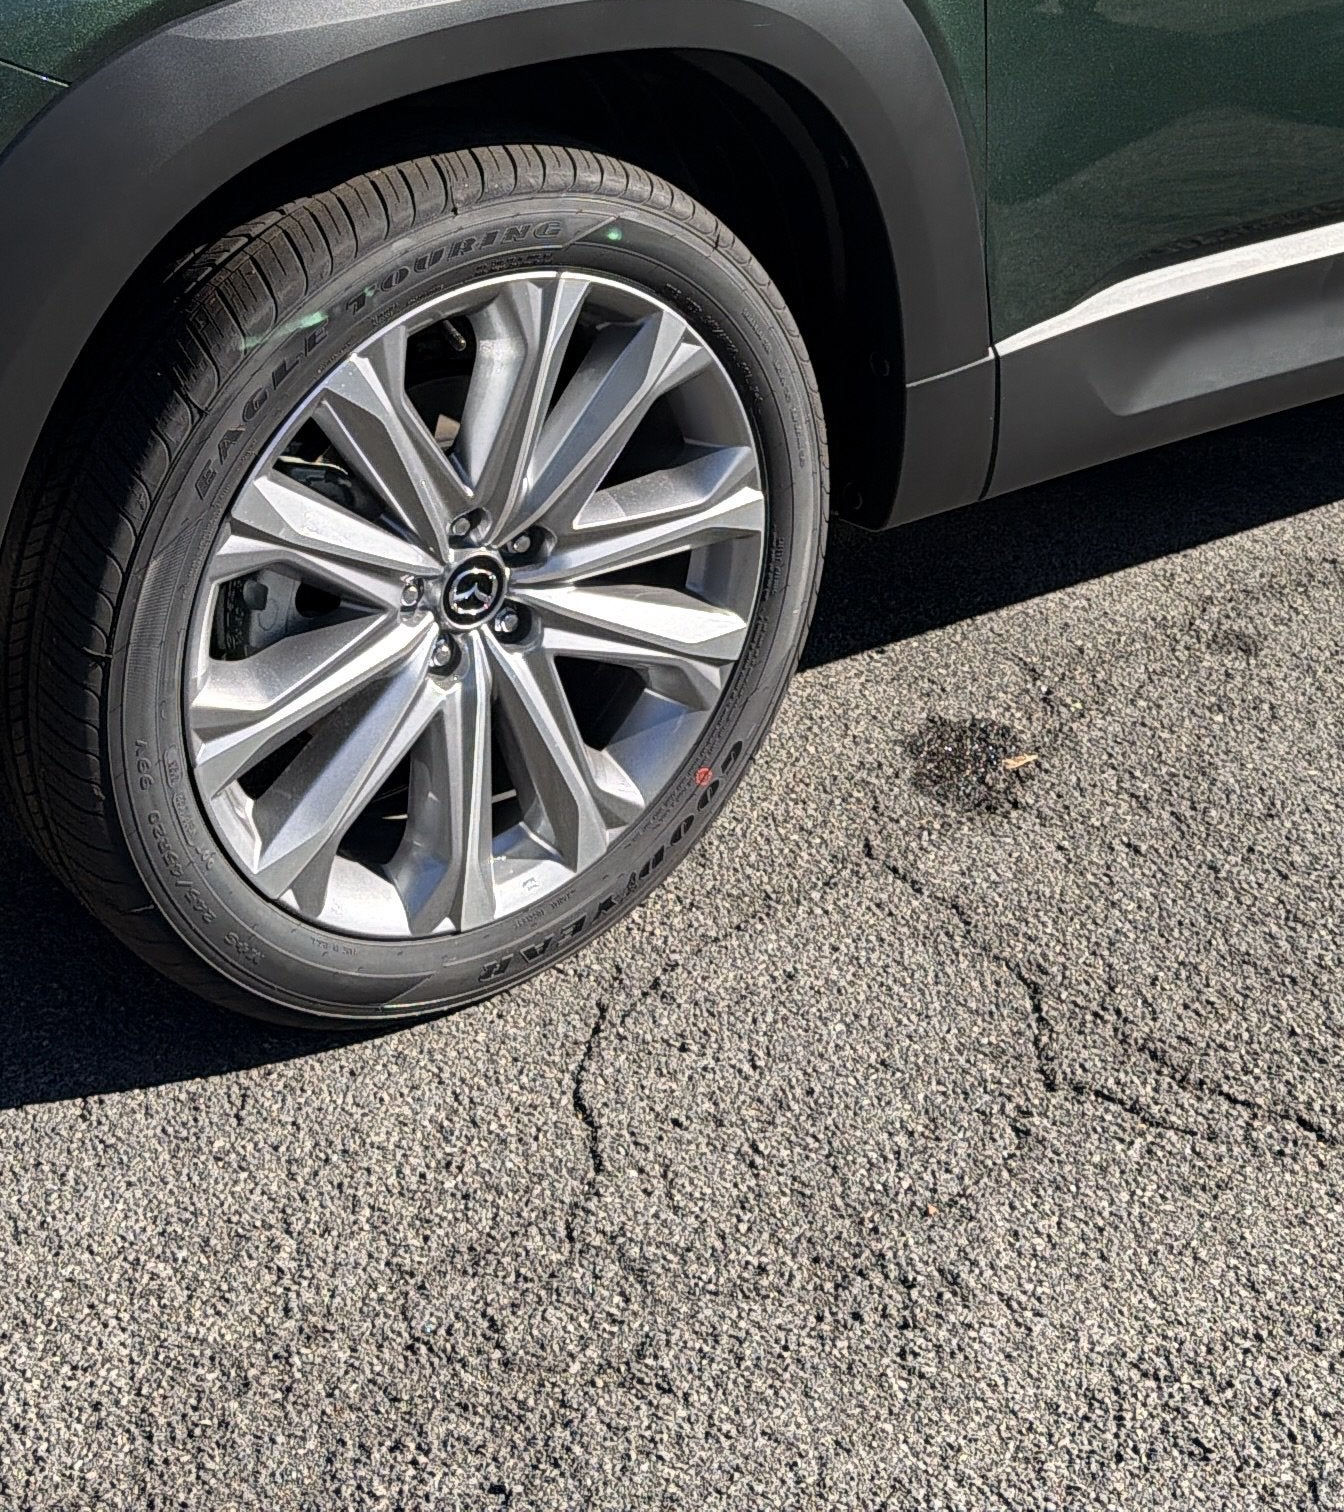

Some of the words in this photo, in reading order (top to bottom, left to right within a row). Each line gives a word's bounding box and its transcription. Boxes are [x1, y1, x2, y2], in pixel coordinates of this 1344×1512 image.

[194, 318, 329, 501] EAGLE
[344, 221, 562, 316] TOURING
[147, 809, 217, 924] 245/45R20
[478, 740, 743, 982] GOODYEAR
